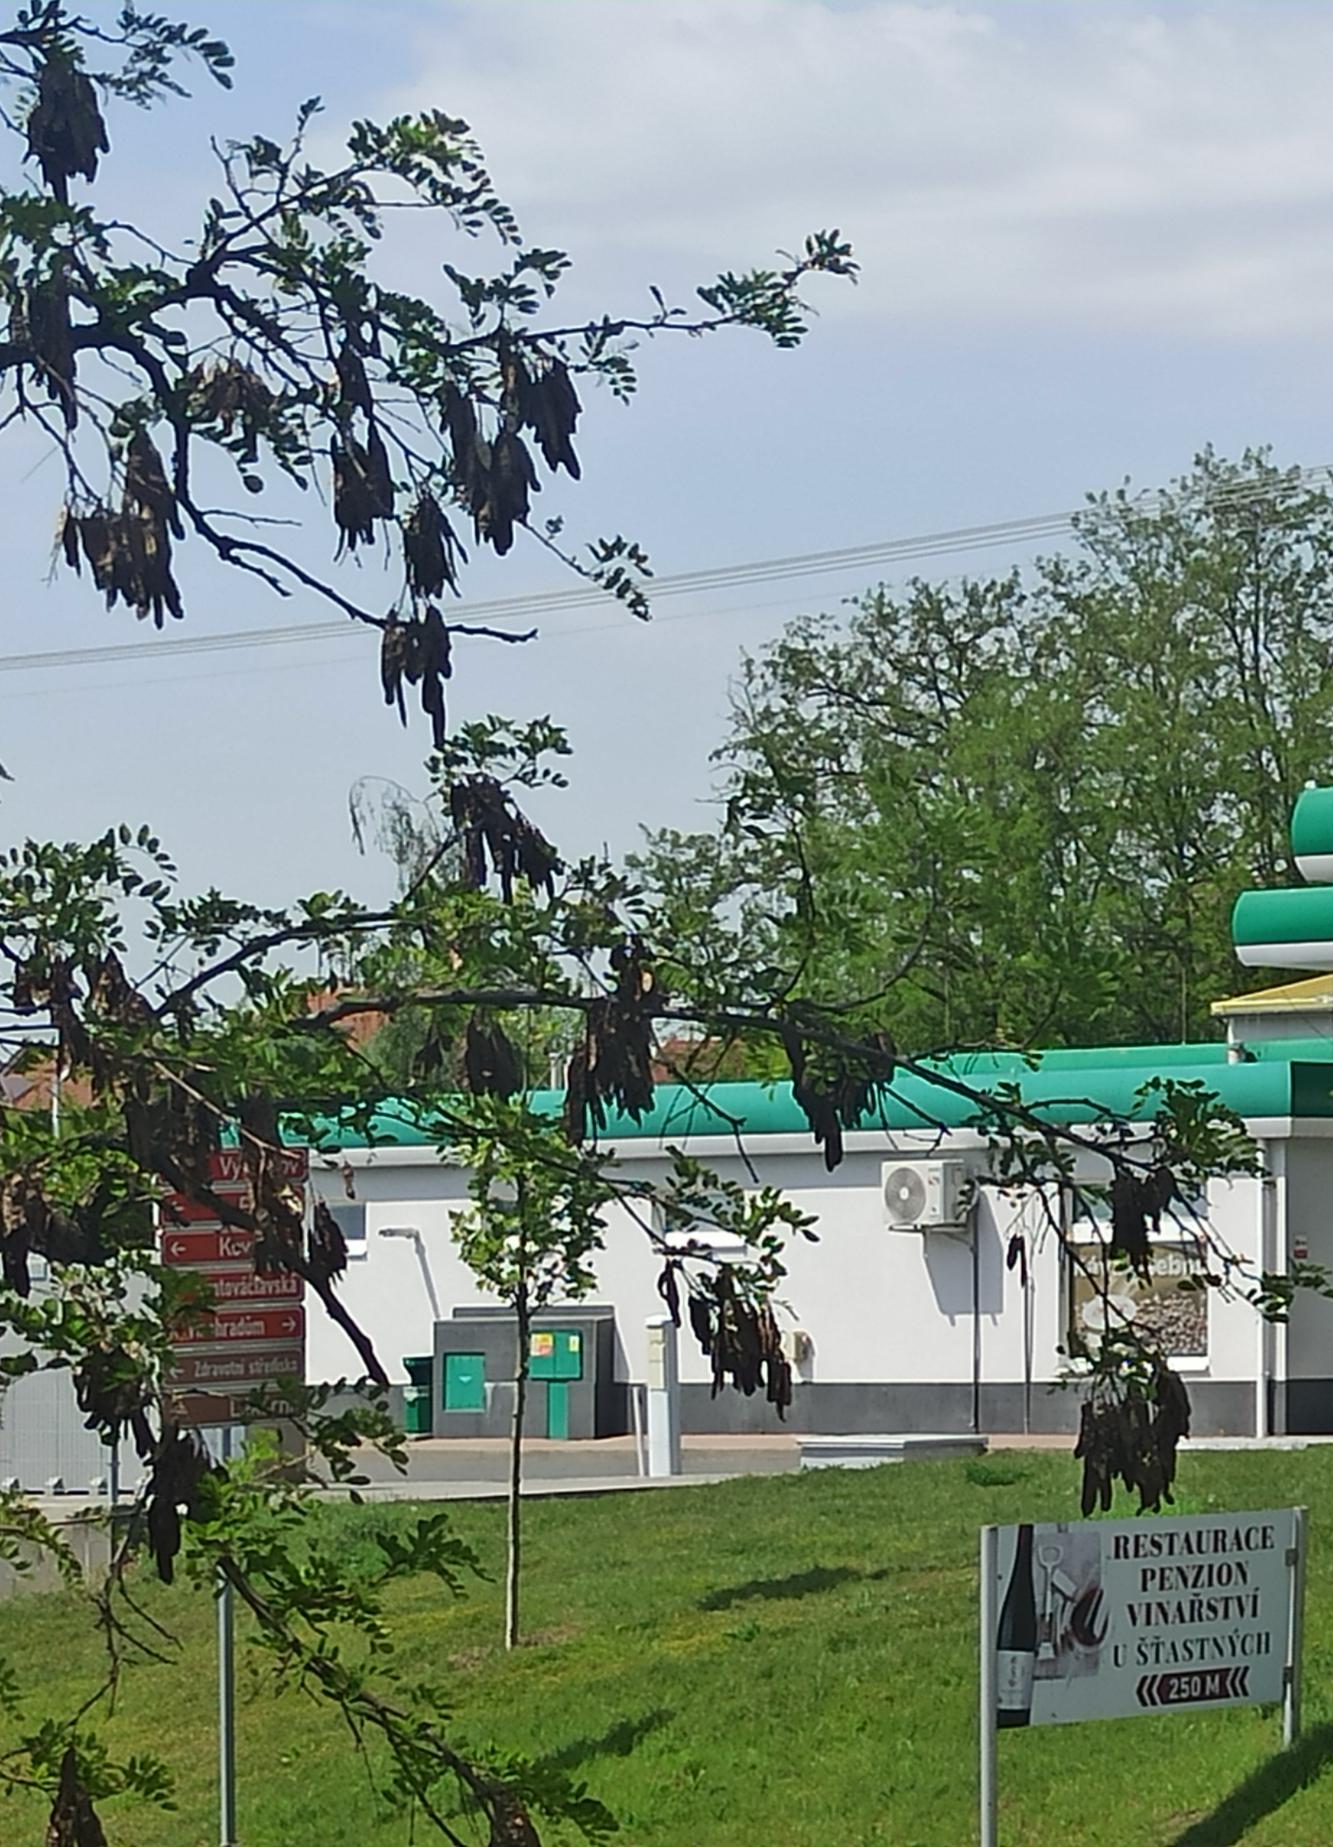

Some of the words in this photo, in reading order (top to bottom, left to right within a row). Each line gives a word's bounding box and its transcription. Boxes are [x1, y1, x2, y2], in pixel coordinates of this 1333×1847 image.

[1112, 1525, 1275, 1560] RESTAURACE
[1140, 1561, 1249, 1593] PENZION
[1127, 1587, 1261, 1628] VINAŘSTVÍ
[1112, 1643, 1128, 1668] U
[1136, 1628, 1272, 1667] ŠŤASTNÝCH
[1168, 1677, 1201, 1700] 250
[1205, 1674, 1221, 1695] M
